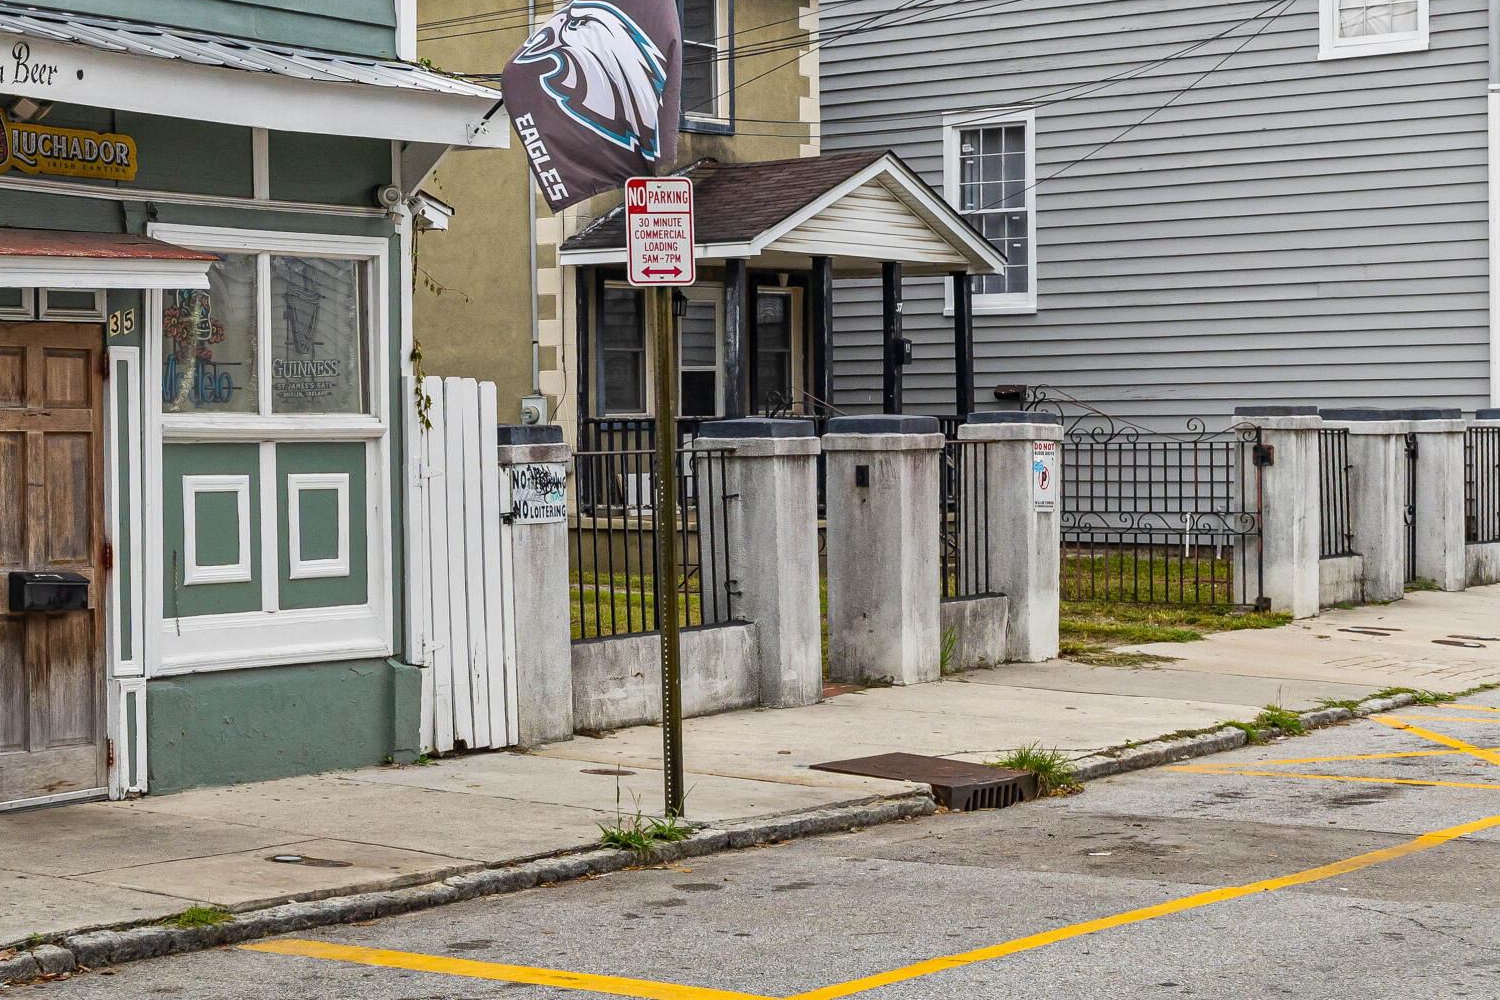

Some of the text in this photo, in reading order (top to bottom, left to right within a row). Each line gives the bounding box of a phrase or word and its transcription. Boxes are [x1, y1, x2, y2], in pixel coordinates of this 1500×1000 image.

[12, 40, 59, 86] Beer
[12, 128, 130, 166] LUCHADOR
[514, 112, 569, 201] EAGLES
[47, 161, 128, 174] IRISH CANTINA
[628, 186, 688, 207] NO PARKING
[638, 217, 682, 227] 30 MINUTE
[634, 229, 687, 239] COMMERCIAL
[644, 241, 678, 252] LOADING
[111, 310, 134, 334] 35
[273, 358, 338, 378] GUINNESS
[512, 470, 527, 489] NO
[513, 500, 566, 519] NO LOITERING
